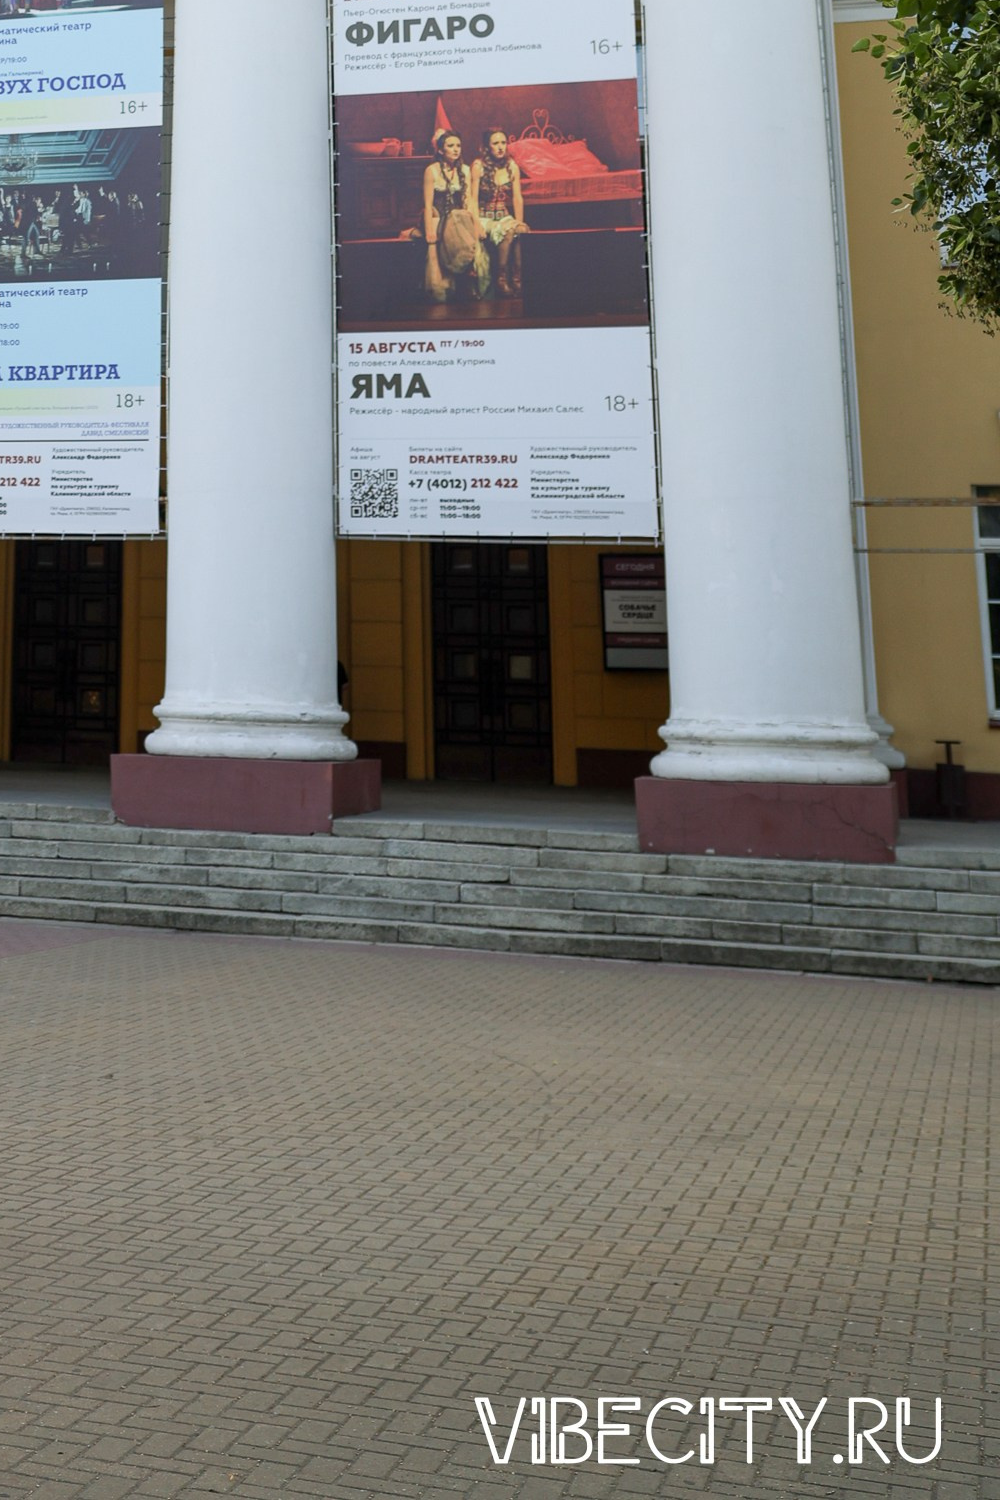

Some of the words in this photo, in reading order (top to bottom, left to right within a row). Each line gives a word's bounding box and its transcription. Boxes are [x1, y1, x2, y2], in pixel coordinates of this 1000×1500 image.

[344, 5, 405, 17] Пьер-Огюстен
[408, 4, 434, 13] Карон
[437, 4, 448, 12] де
[450, 1, 491, 12] Бомарше
[62, 21, 91, 31] театр
[345, 14, 495, 47] ФИГАРО
[344, 53, 382, 62] Перевод
[390, 48, 452, 60] французского
[454, 45, 493, 54] Николая
[495, 42, 542, 53] Любимова
[590, 39, 622, 54] 16+
[344, 61, 386, 71] Режиссёр
[395, 61, 415, 70] Егор
[417, 57, 464, 67] Равинский
[37, 73, 126, 92] ГОСПОД
[120, 101, 148, 114] 16+
[58, 287, 88, 297] театр
[349, 343, 363, 354] 15
[367, 342, 436, 353] АВГУСТА
[361, 359, 397, 367] повести
[399, 358, 454, 367] Александра
[457, 357, 495, 366] Куприна
[8, 364, 120, 381] КВАРТИРА
[350, 373, 431, 399] ЯМА
[116, 394, 145, 408] 18+
[605, 396, 638, 412] 18+
[350, 406, 393, 415] Режиссёр
[401, 407, 447, 415] народный
[450, 406, 480, 414] артист
[482, 406, 516, 414] России
[518, 405, 553, 414] Михаил
[556, 405, 583, 413] Салес
[409, 455, 517, 464] DRAMTEATR39.RU
[409, 479, 423, 488] +7
[427, 478, 467, 490] (4012)
[471, 478, 491, 488] 212
[494, 478, 518, 488] 422
